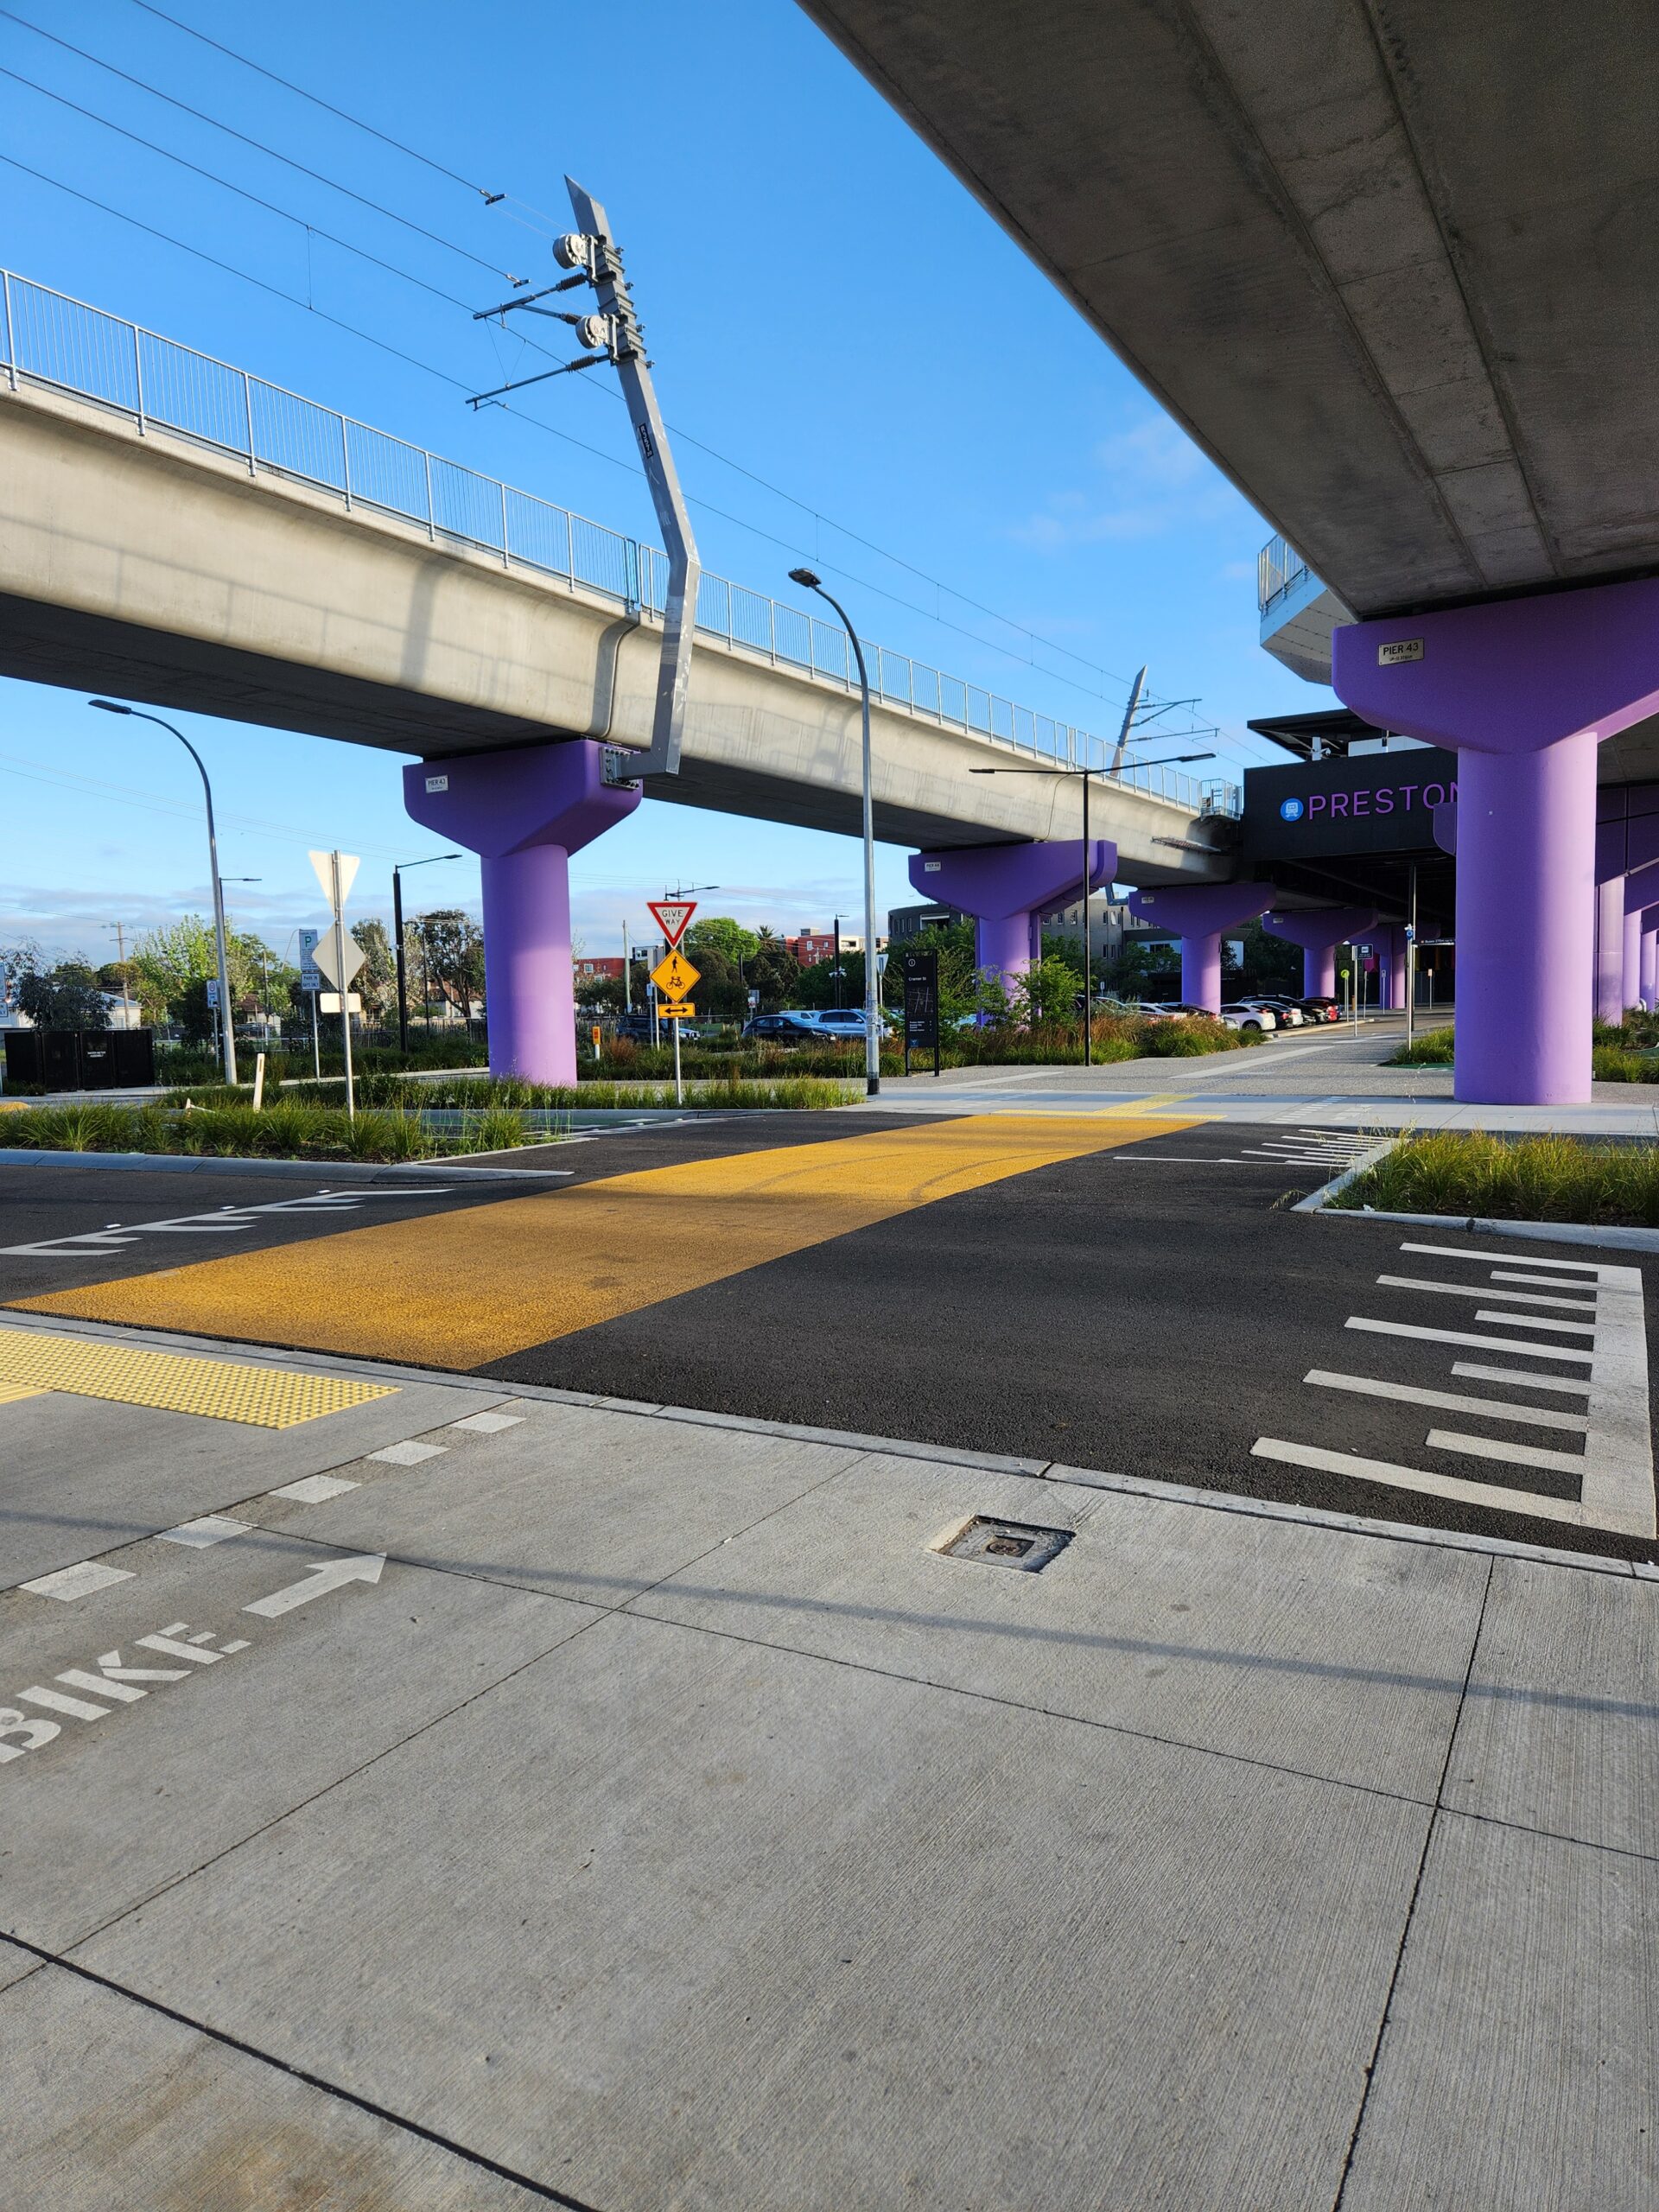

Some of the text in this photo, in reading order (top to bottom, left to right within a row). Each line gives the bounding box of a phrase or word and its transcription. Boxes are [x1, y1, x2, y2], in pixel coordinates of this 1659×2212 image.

[1382, 642, 1419, 656] PIER 43
[662, 909, 683, 918] GIVE
[304, 936, 312, 948] P
[0, 1622, 251, 1763] BIKE
